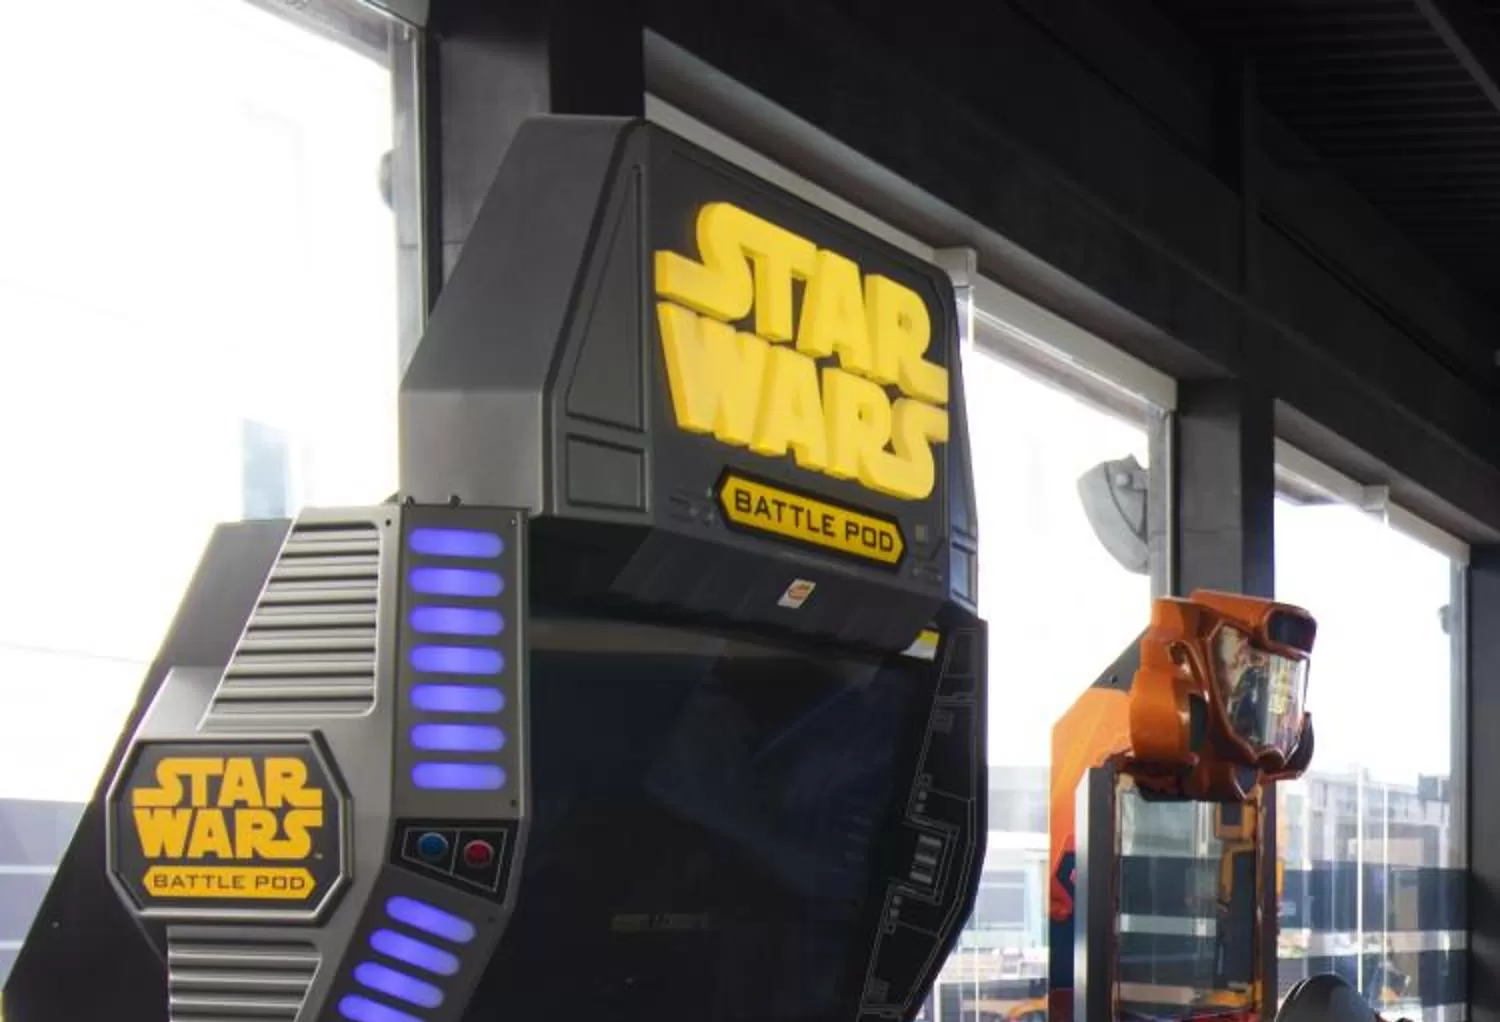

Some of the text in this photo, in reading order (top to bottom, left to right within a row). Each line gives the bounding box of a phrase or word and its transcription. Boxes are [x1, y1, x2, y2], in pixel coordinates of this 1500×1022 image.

[655, 203, 949, 405] STAR
[657, 303, 949, 500] WARS
[735, 489, 894, 554] BATTLE POD
[132, 757, 323, 807] STAR
[132, 807, 323, 860] WARS
[153, 874, 306, 892] BATTLE POD
